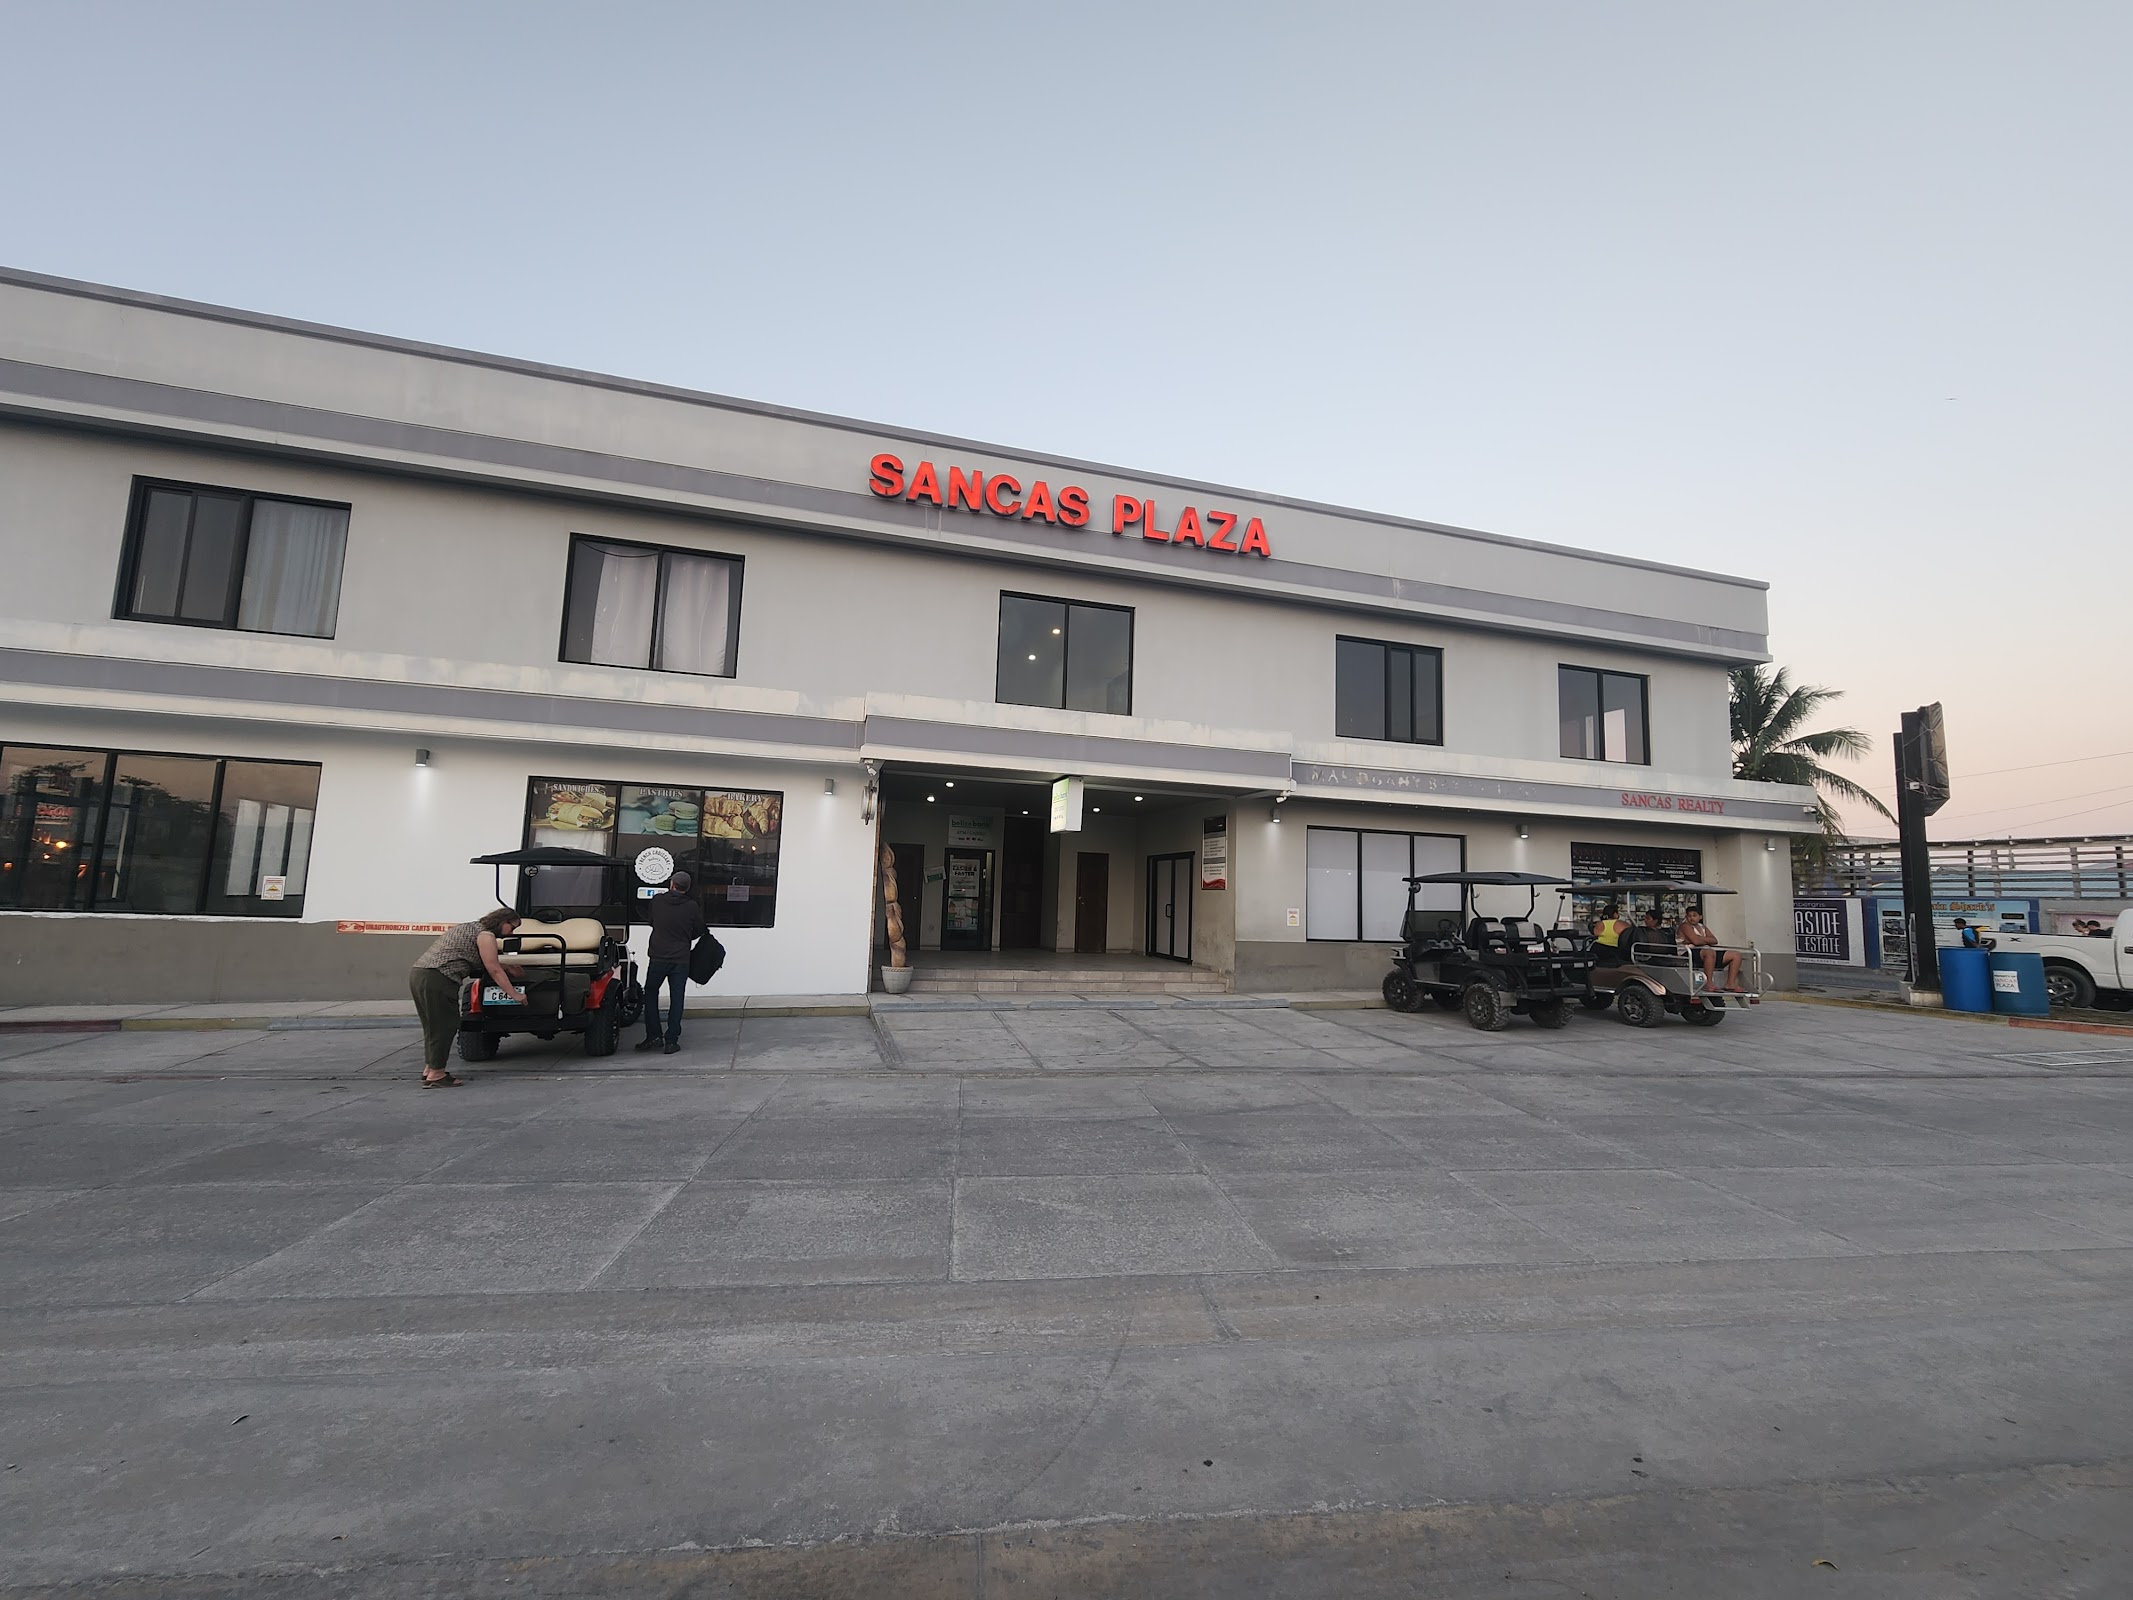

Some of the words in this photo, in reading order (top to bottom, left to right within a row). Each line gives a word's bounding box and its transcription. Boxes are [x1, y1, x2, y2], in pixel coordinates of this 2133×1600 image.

[868, 453, 1091, 528] SANCAS
[1111, 494, 1272, 558] PLAZA
[552, 783, 600, 795] SANDWICHES
[639, 787, 683, 798] PASTRIES
[727, 792, 763, 802] BAKERY
[1621, 793, 1672, 810] SANCAS
[1677, 797, 1725, 814] REALTY
[365, 923, 409, 931] UNAUTHORIZED
[411, 924, 431, 932] CARTS
[1804, 936, 1841, 953] ESTATE
[491, 992, 497, 1000] C
